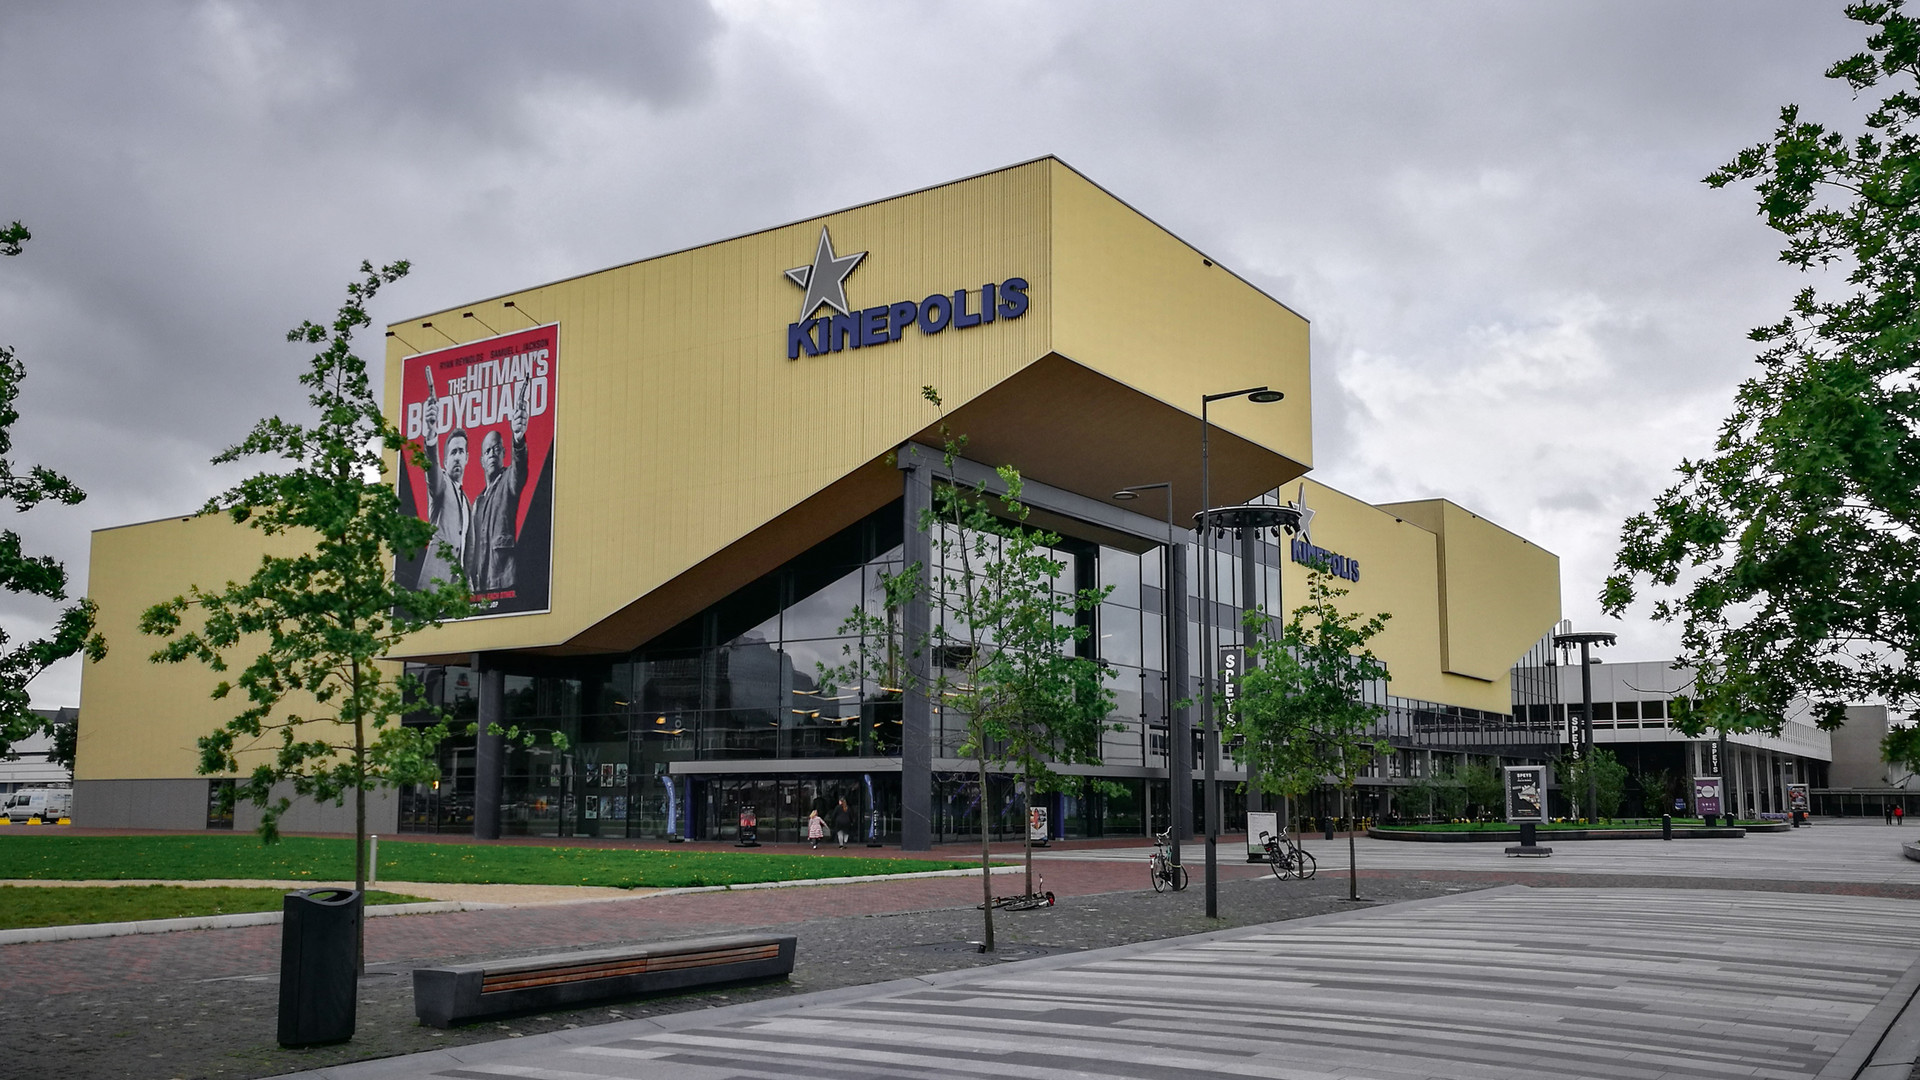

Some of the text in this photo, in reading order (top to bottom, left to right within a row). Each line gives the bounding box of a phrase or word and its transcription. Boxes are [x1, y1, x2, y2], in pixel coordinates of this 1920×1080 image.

[787, 277, 1030, 360] KINEPOLIS
[447, 348, 549, 395] THE HITMAN'S
[1225, 654, 1237, 728] SPEYS
[1571, 716, 1580, 759] SPEYS
[1711, 742, 1719, 773] SPEYS
